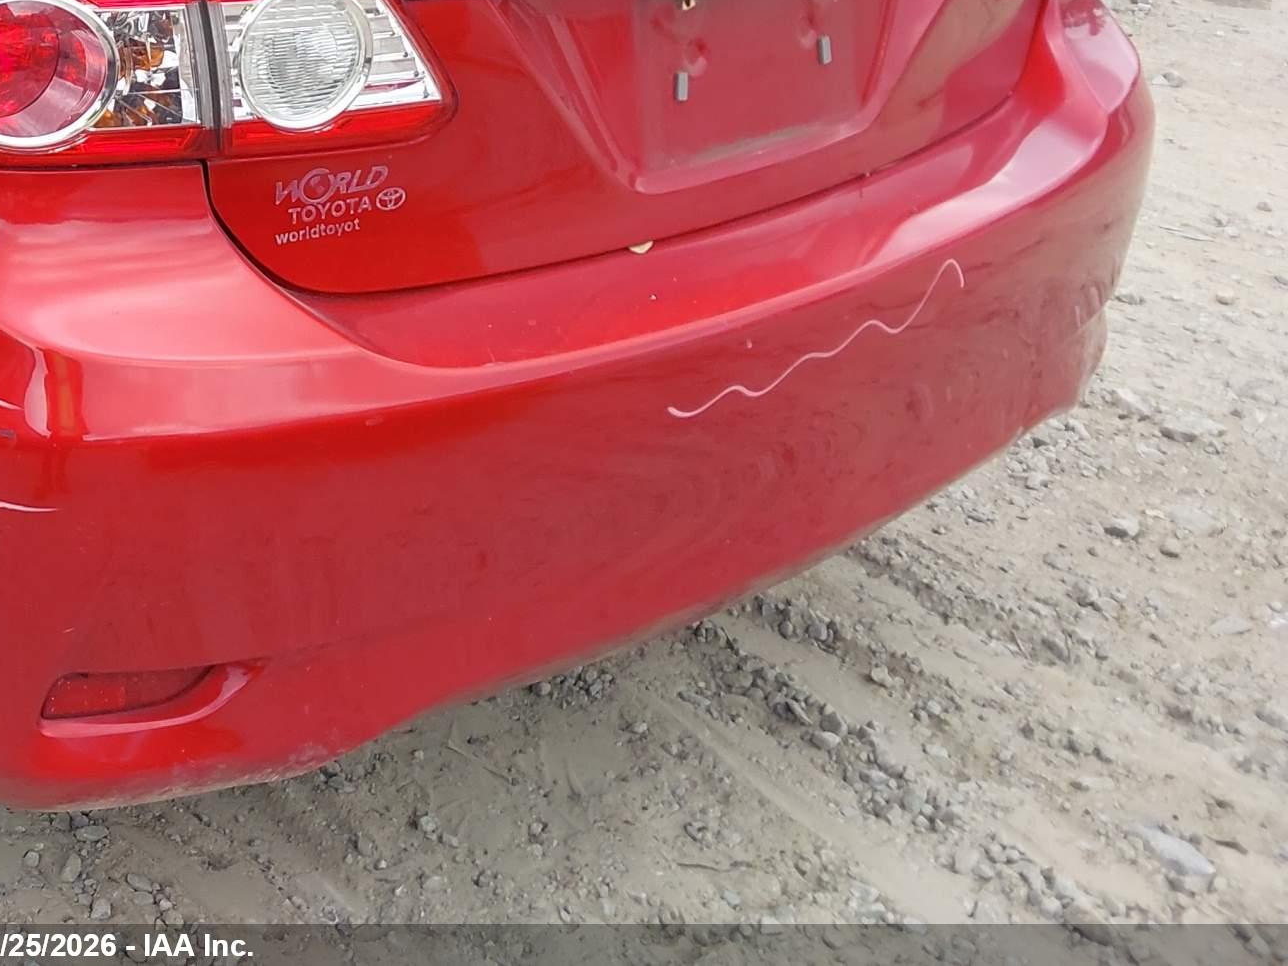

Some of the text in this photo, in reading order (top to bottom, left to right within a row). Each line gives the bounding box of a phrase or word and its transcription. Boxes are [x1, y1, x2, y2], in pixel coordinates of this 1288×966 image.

[275, 165, 389, 206] WORLD
[288, 195, 372, 224] TOYOTA
[275, 218, 360, 245] worldtoyot
